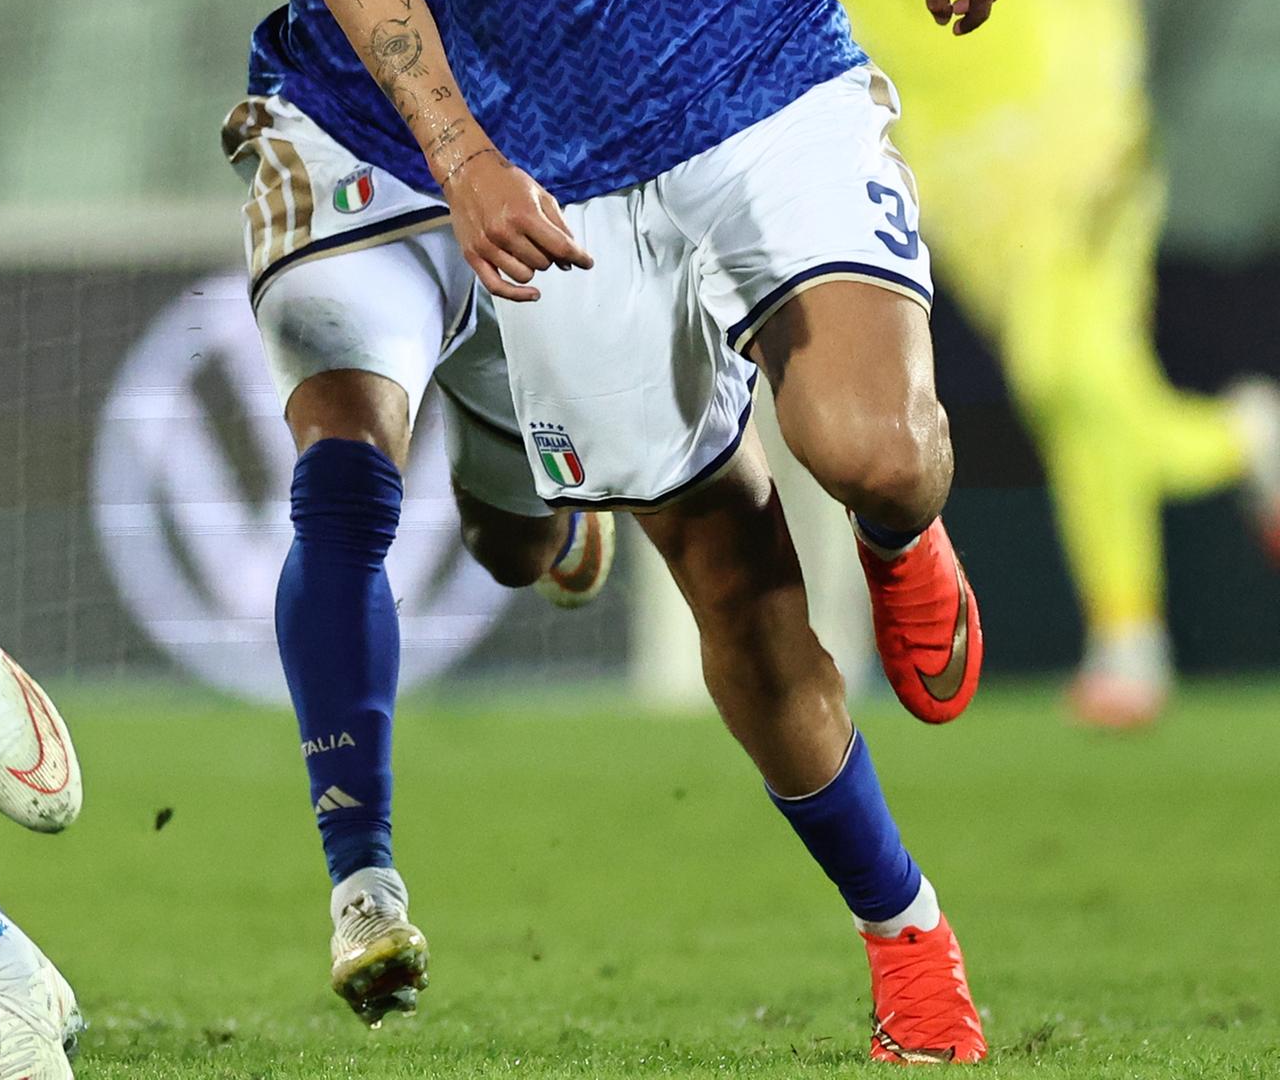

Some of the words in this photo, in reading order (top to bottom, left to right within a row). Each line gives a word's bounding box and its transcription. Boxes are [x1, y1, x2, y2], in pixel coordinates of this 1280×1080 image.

[431, 86, 451, 101] 33
[866, 180, 918, 260] 3
[535, 436, 571, 448] ITALIA
[301, 732, 356, 758] TALIA
